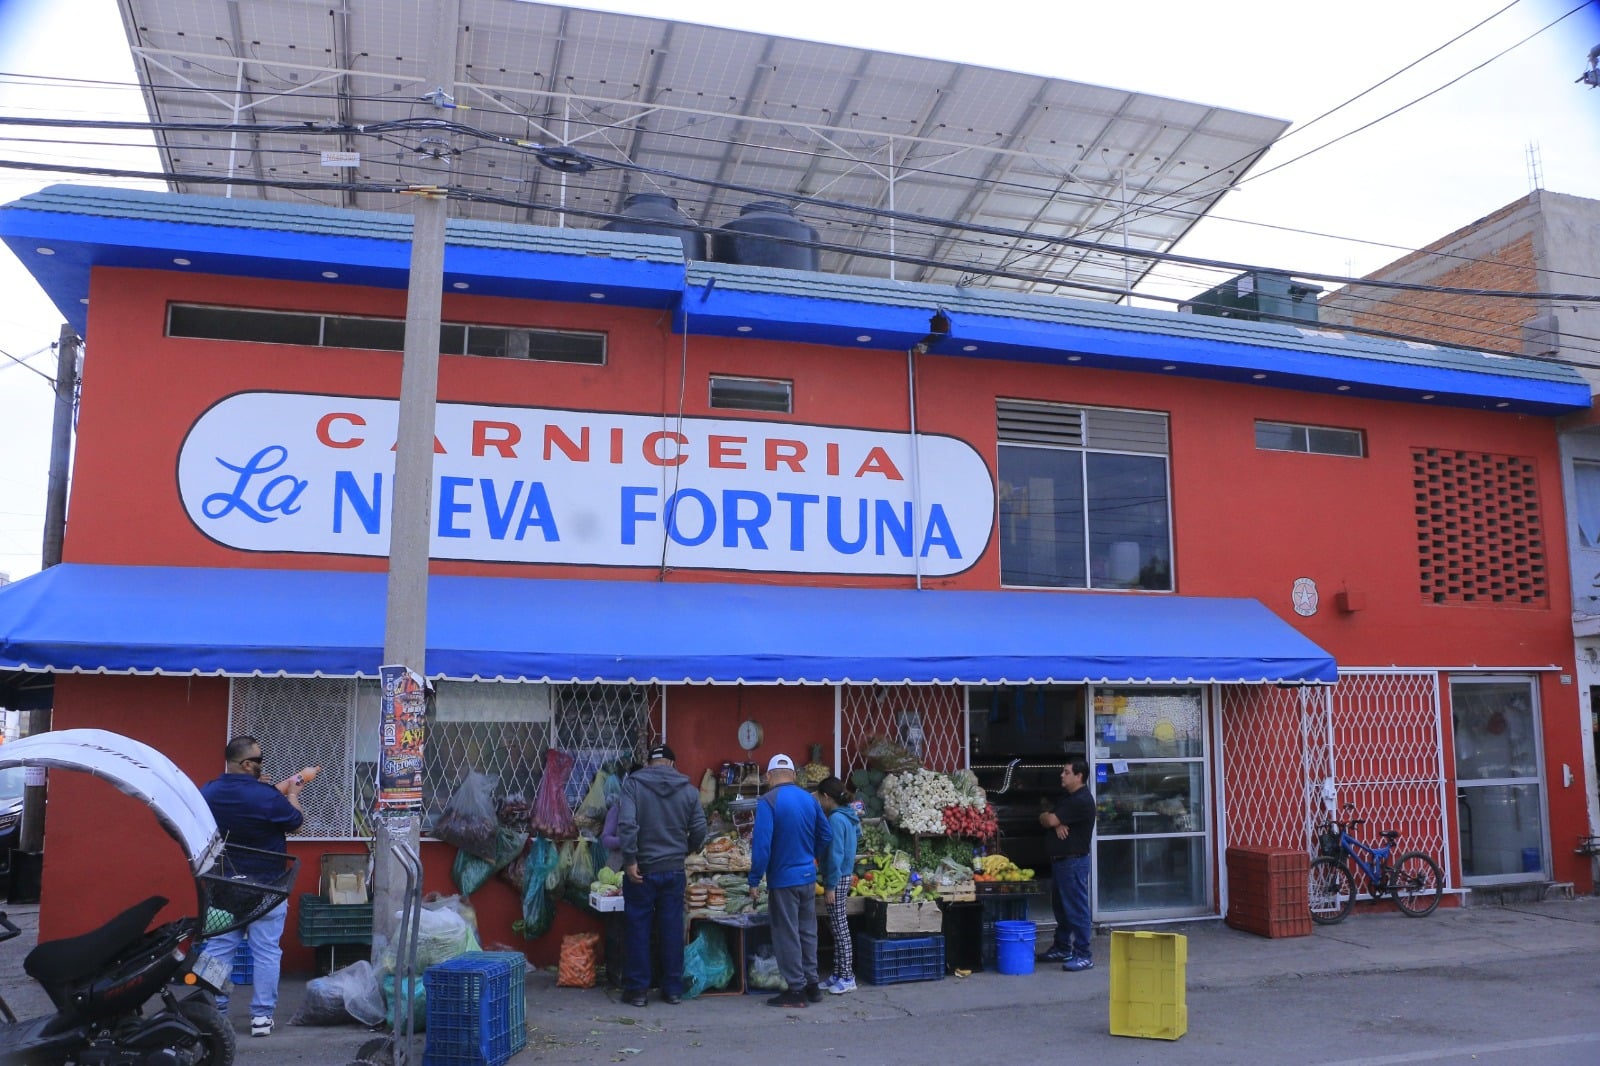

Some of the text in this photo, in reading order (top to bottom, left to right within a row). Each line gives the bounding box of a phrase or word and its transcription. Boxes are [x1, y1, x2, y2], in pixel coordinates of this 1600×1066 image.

[316, 412, 904, 480] CRNICERIA
[201, 445, 963, 559] La NEVA FORTUNA
